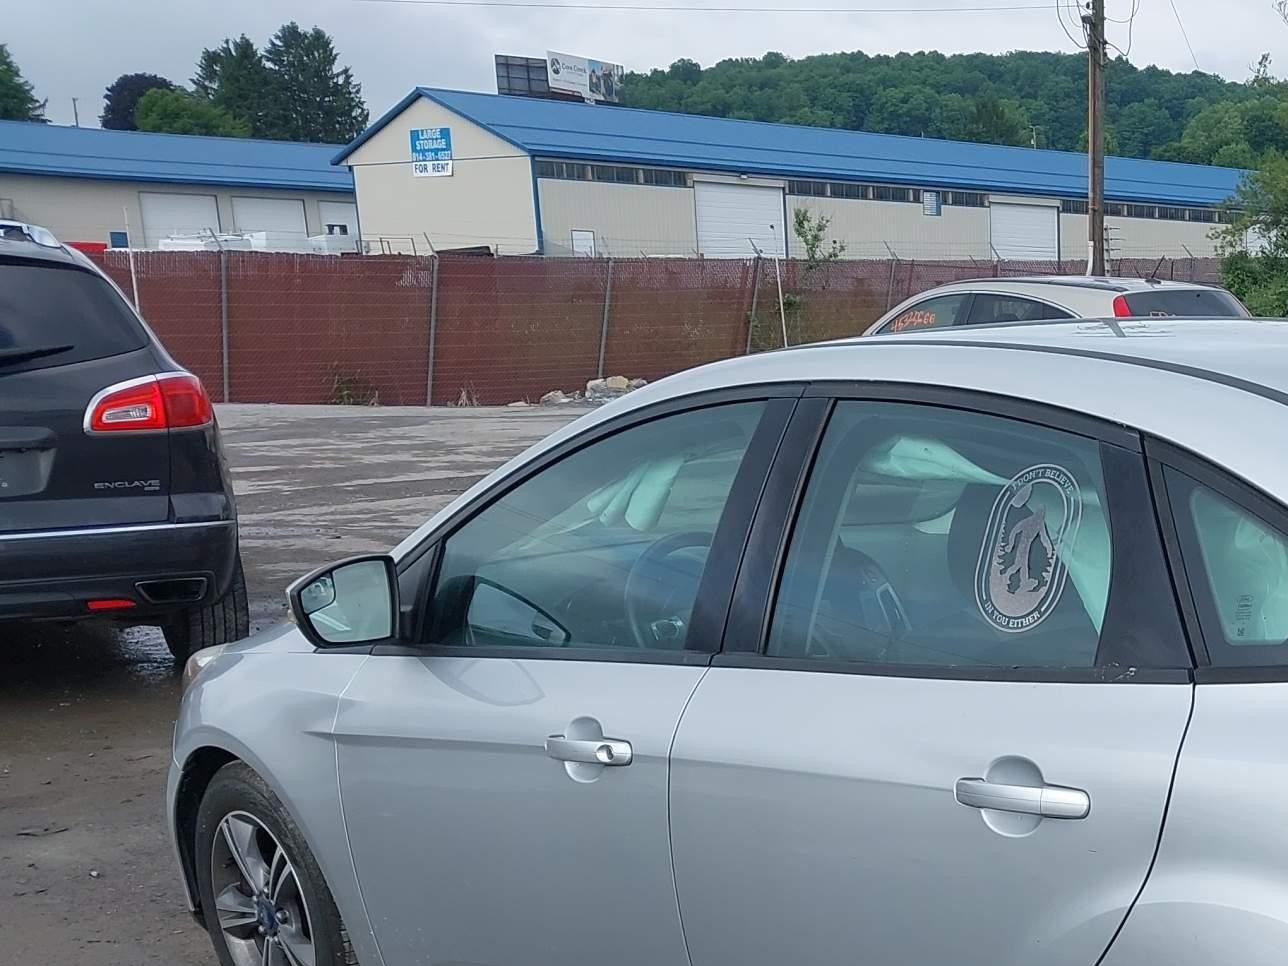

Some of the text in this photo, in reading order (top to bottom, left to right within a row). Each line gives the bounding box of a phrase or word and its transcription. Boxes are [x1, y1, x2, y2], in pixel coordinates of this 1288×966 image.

[419, 129, 441, 139] LARGE
[416, 139, 447, 150] STORAGE
[414, 163, 449, 173] FOR RENT
[94, 480, 160, 489] ENCLAVE
[1017, 468, 1045, 486] DON'T
[1045, 469, 1074, 495] BELIEVE
[985, 601, 1041, 628] IN YOU EITHER
